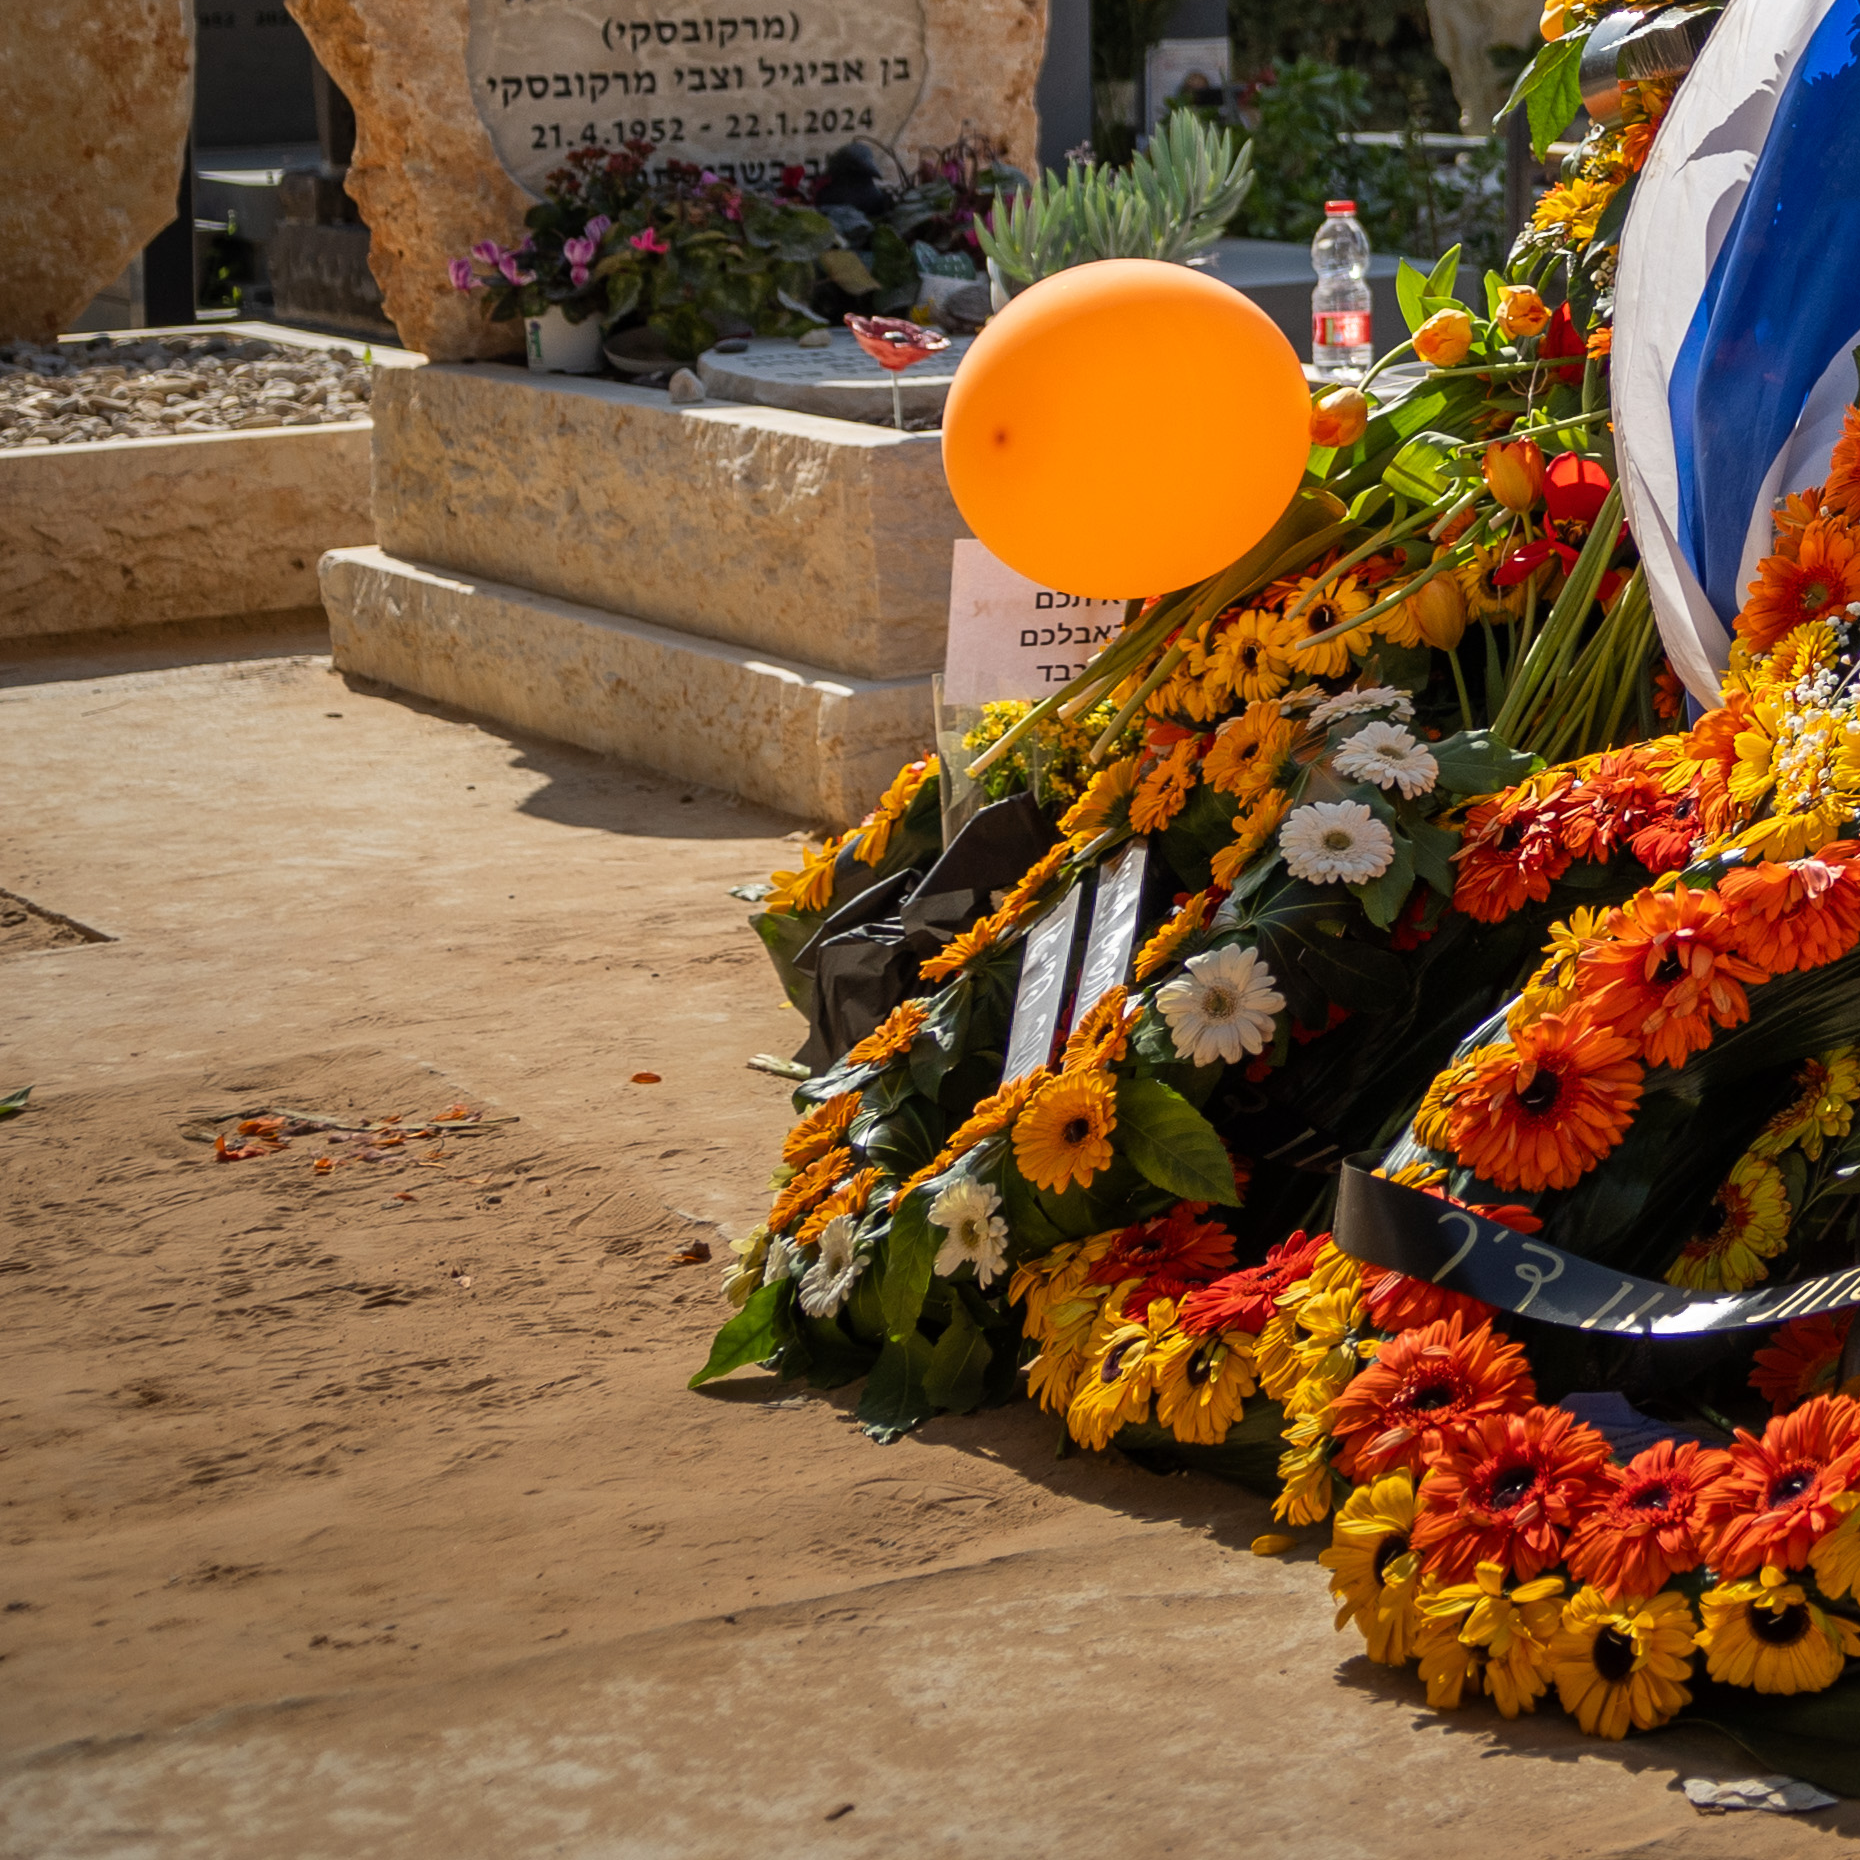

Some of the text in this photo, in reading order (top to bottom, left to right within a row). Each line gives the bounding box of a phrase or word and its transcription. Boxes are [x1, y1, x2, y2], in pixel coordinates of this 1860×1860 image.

[602, 10, 800, 53] (מרקובסקי)
[486, 55, 911, 108] בן אביגיל וצבי מרקובסקי
[531, 117, 685, 150] 21.4.1952
[725, 107, 874, 138] 22.1.2024
